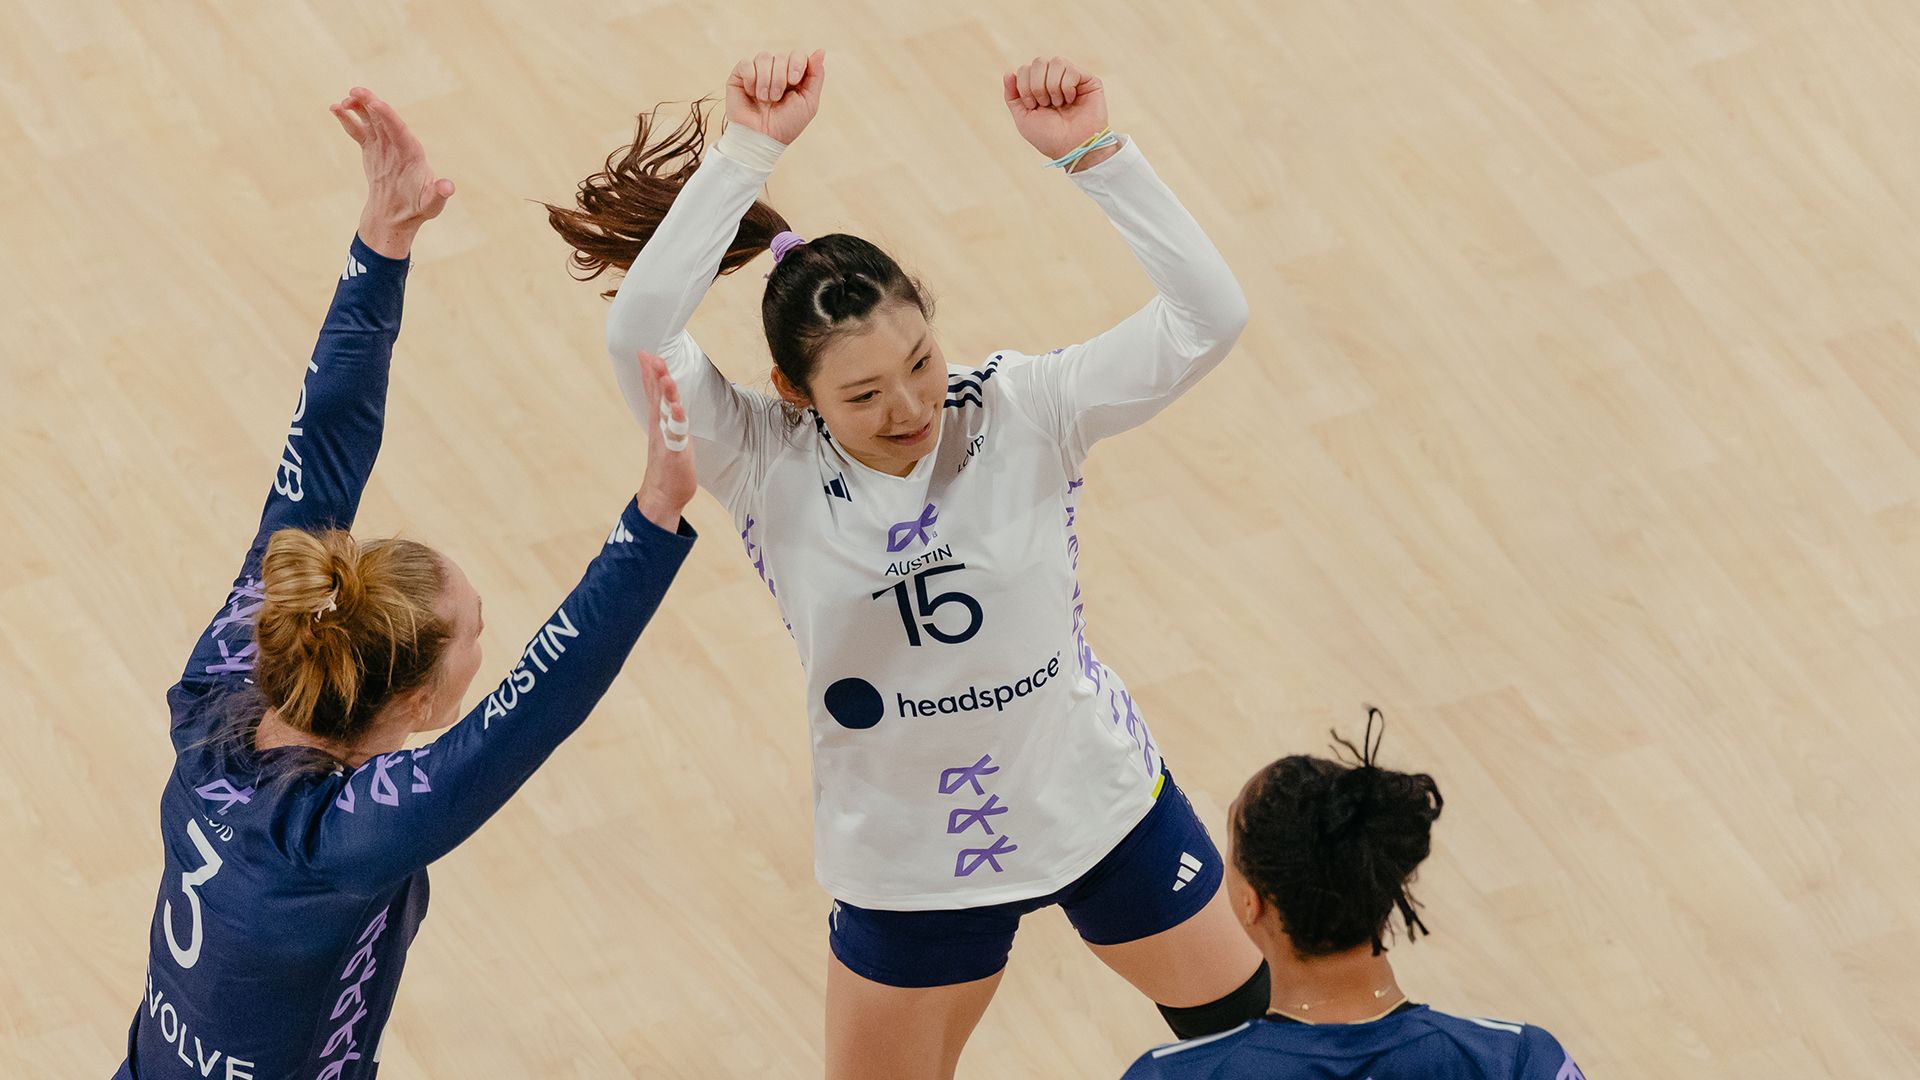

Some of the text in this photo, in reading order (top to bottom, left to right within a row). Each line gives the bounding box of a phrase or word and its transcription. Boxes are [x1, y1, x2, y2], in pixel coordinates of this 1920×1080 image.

[884, 544, 953, 577] AUSTIN
[872, 562, 984, 648] 15
[483, 607, 581, 730] AUSTIN
[896, 656, 1059, 718] headspace
[163, 818, 223, 968] 3
